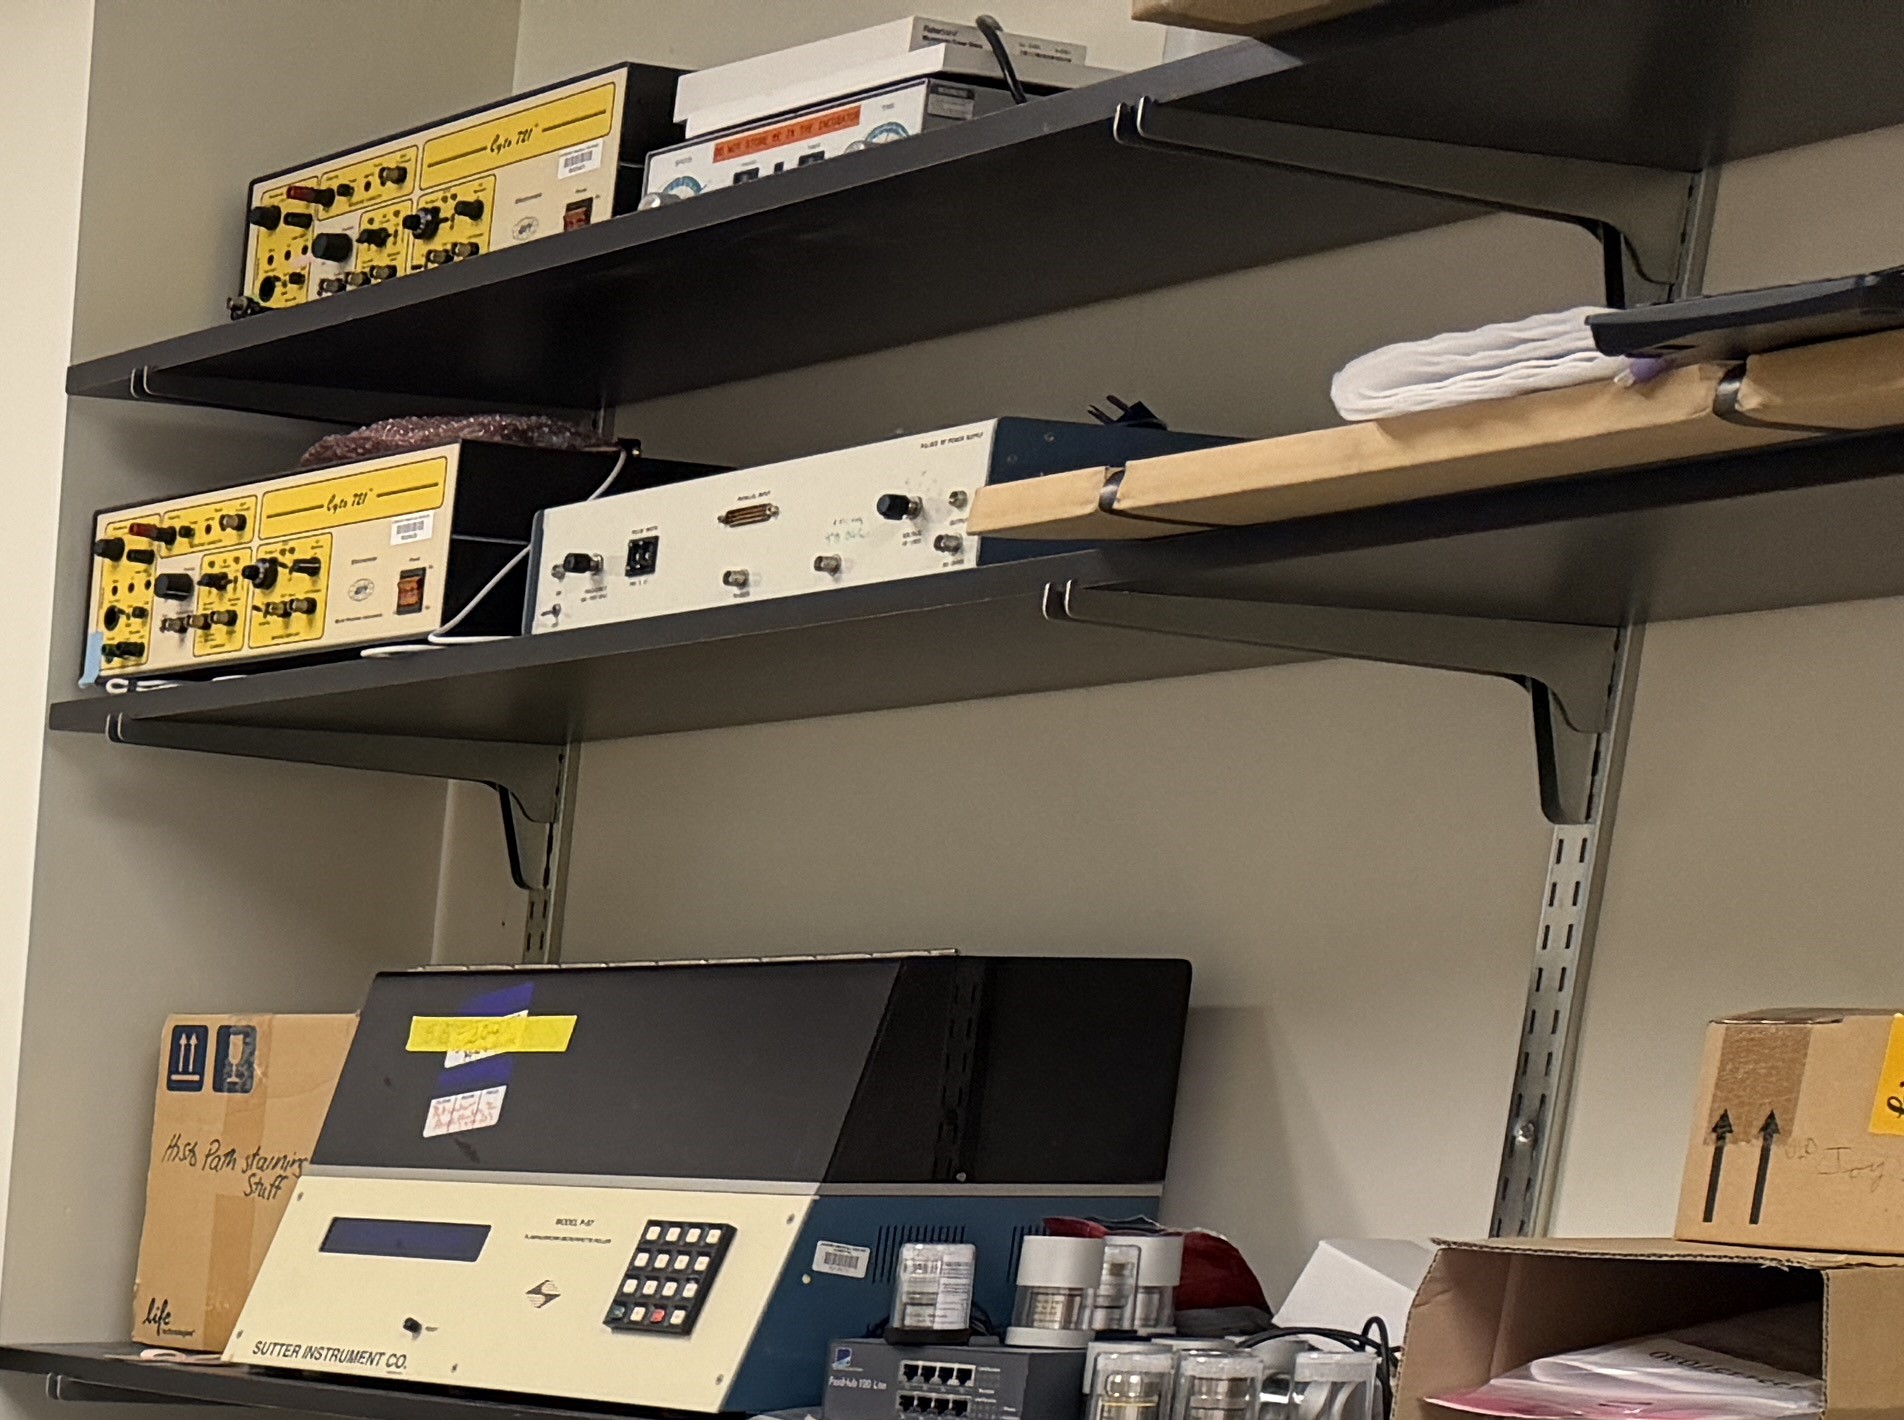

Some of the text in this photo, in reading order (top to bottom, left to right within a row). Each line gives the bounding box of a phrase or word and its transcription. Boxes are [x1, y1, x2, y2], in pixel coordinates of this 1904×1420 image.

[243, 1173, 288, 1201] Stuff
[142, 1297, 172, 1337] life
[252, 1340, 407, 1369] SUTTER INSTRUMENT CO.
